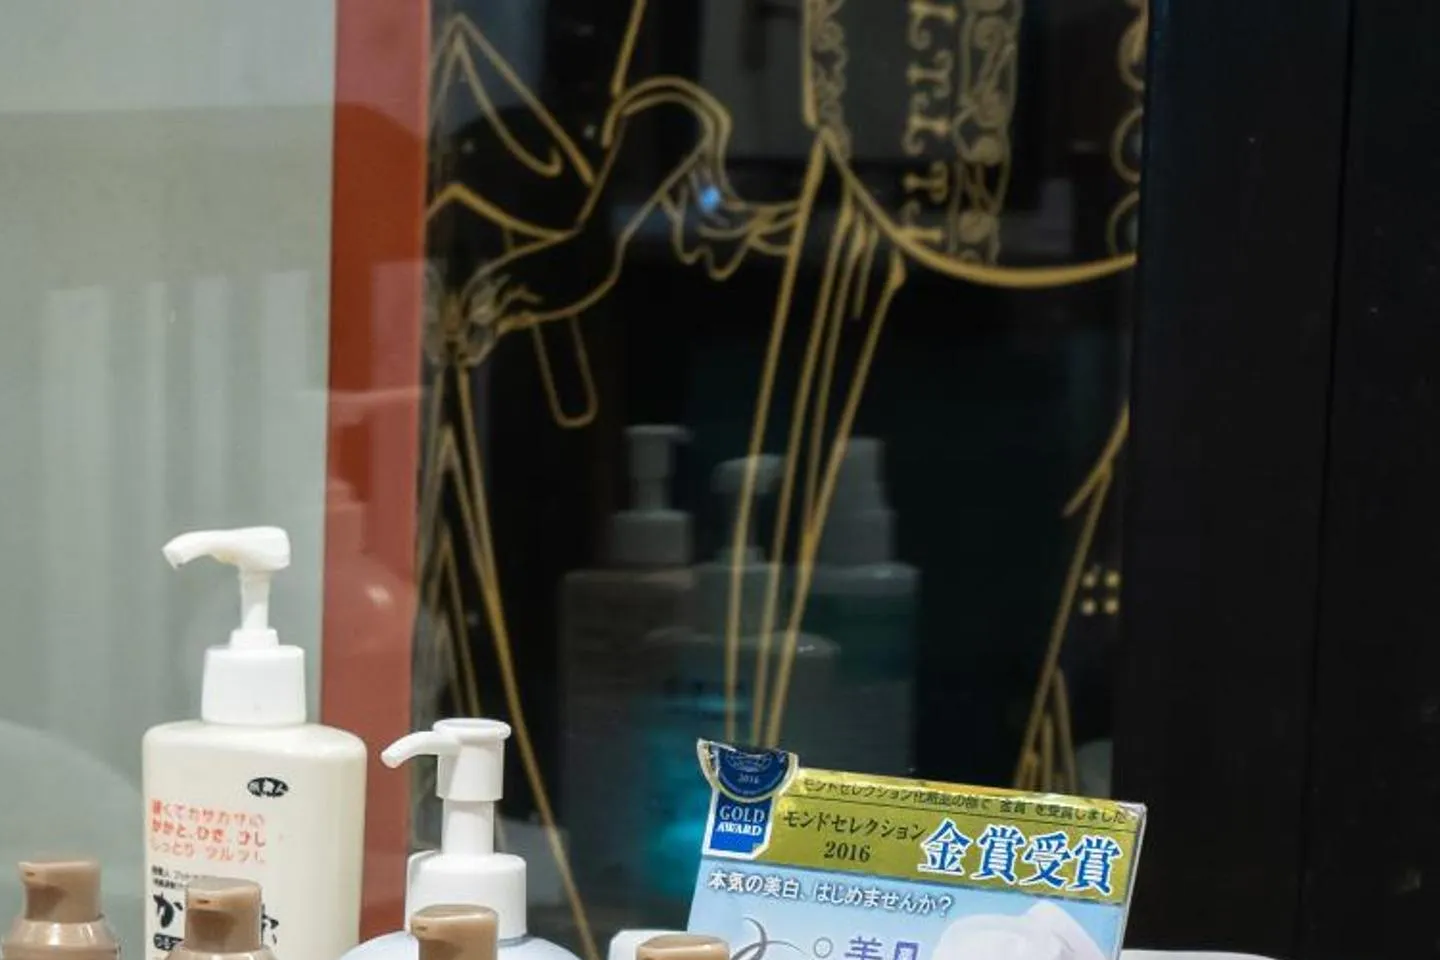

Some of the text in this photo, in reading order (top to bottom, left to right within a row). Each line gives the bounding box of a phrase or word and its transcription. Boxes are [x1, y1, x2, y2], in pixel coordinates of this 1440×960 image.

[719, 806, 765, 824] GOLD
[715, 822, 763, 836] AWARD
[783, 810, 926, 843] モンドセレクション
[823, 842, 871, 862] 2016
[918, 817, 1123, 896] 金賞受賞
